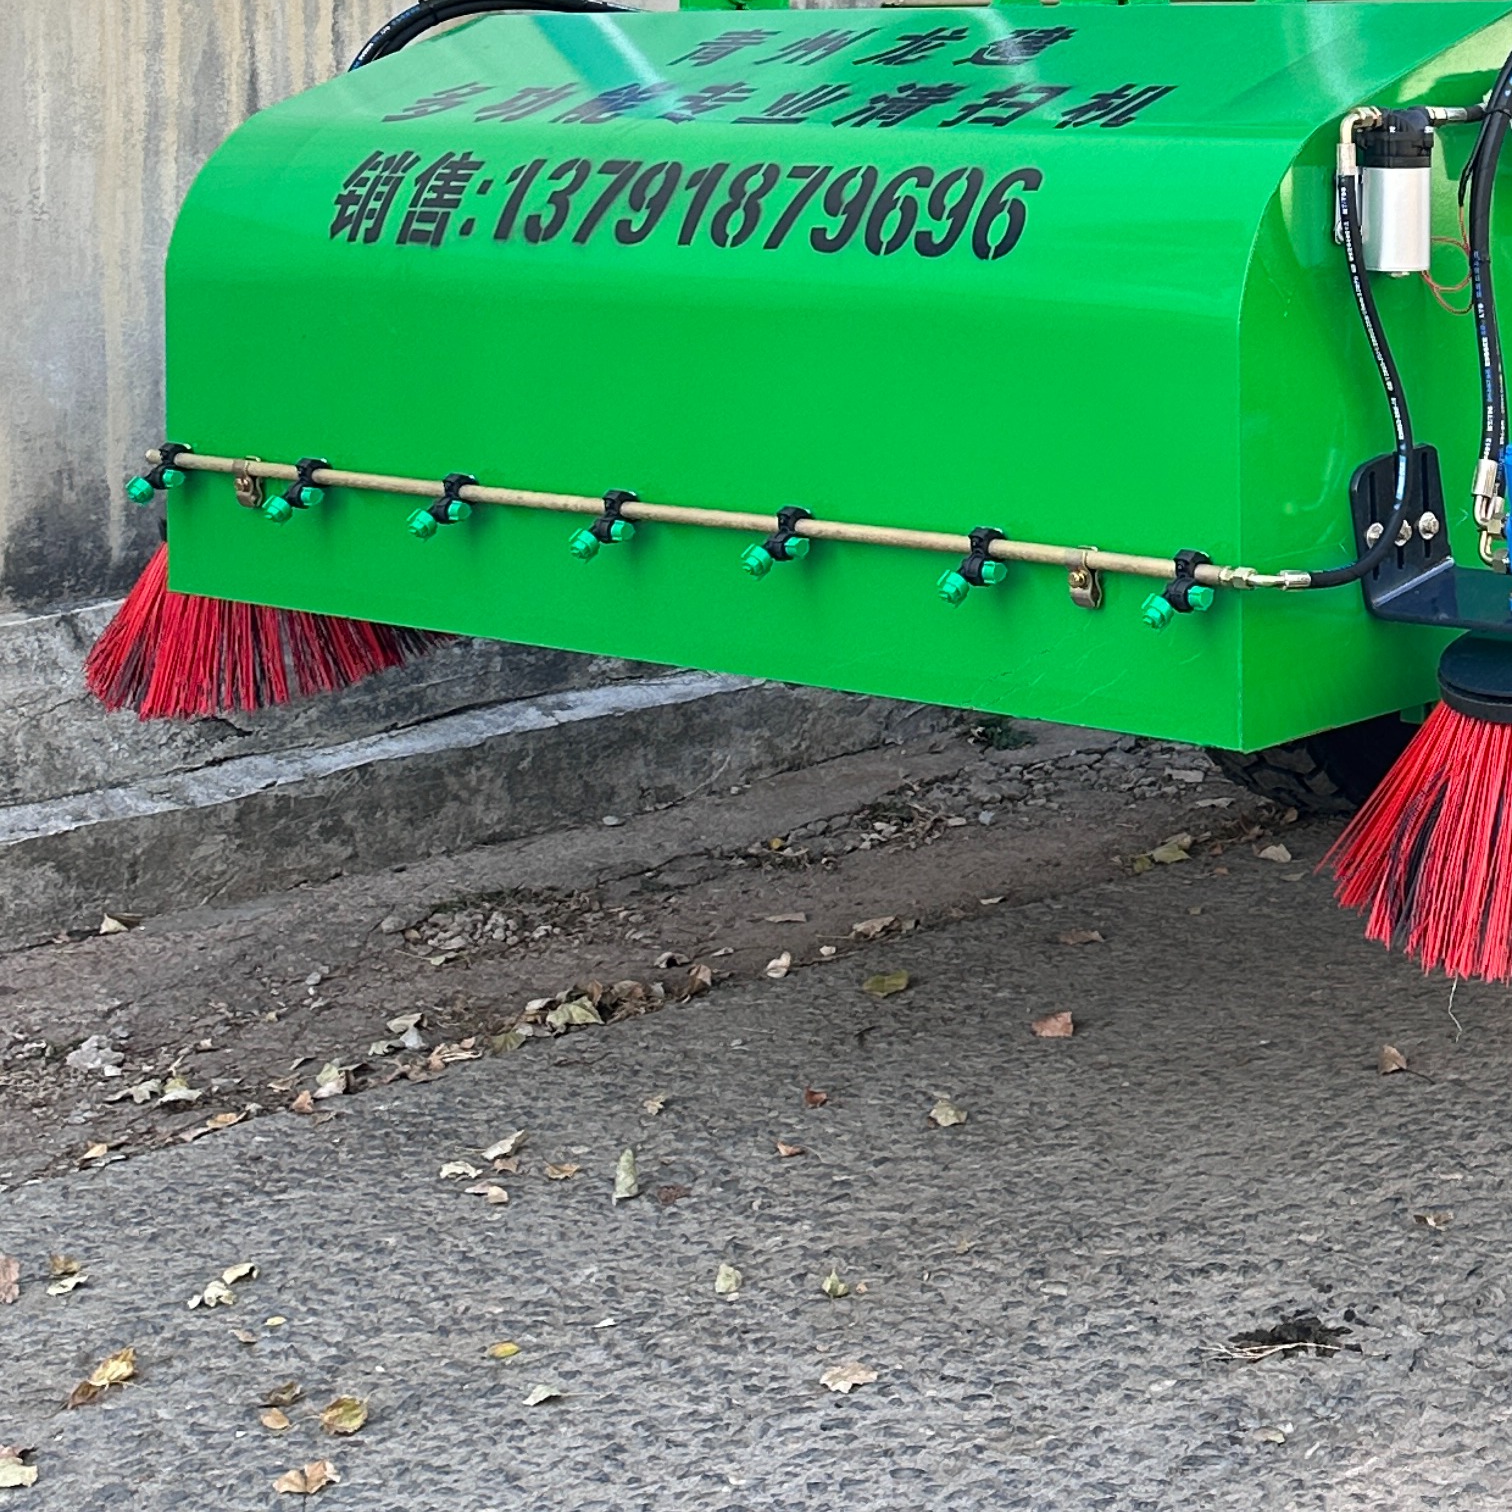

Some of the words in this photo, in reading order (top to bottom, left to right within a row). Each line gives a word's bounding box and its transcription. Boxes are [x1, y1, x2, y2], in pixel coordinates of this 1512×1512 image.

[668, 27, 1078, 67] 青州龙建
[381, 82, 1179, 128] 多功能专业清扫机
[330, 150, 1043, 261] 销售:13791879696
